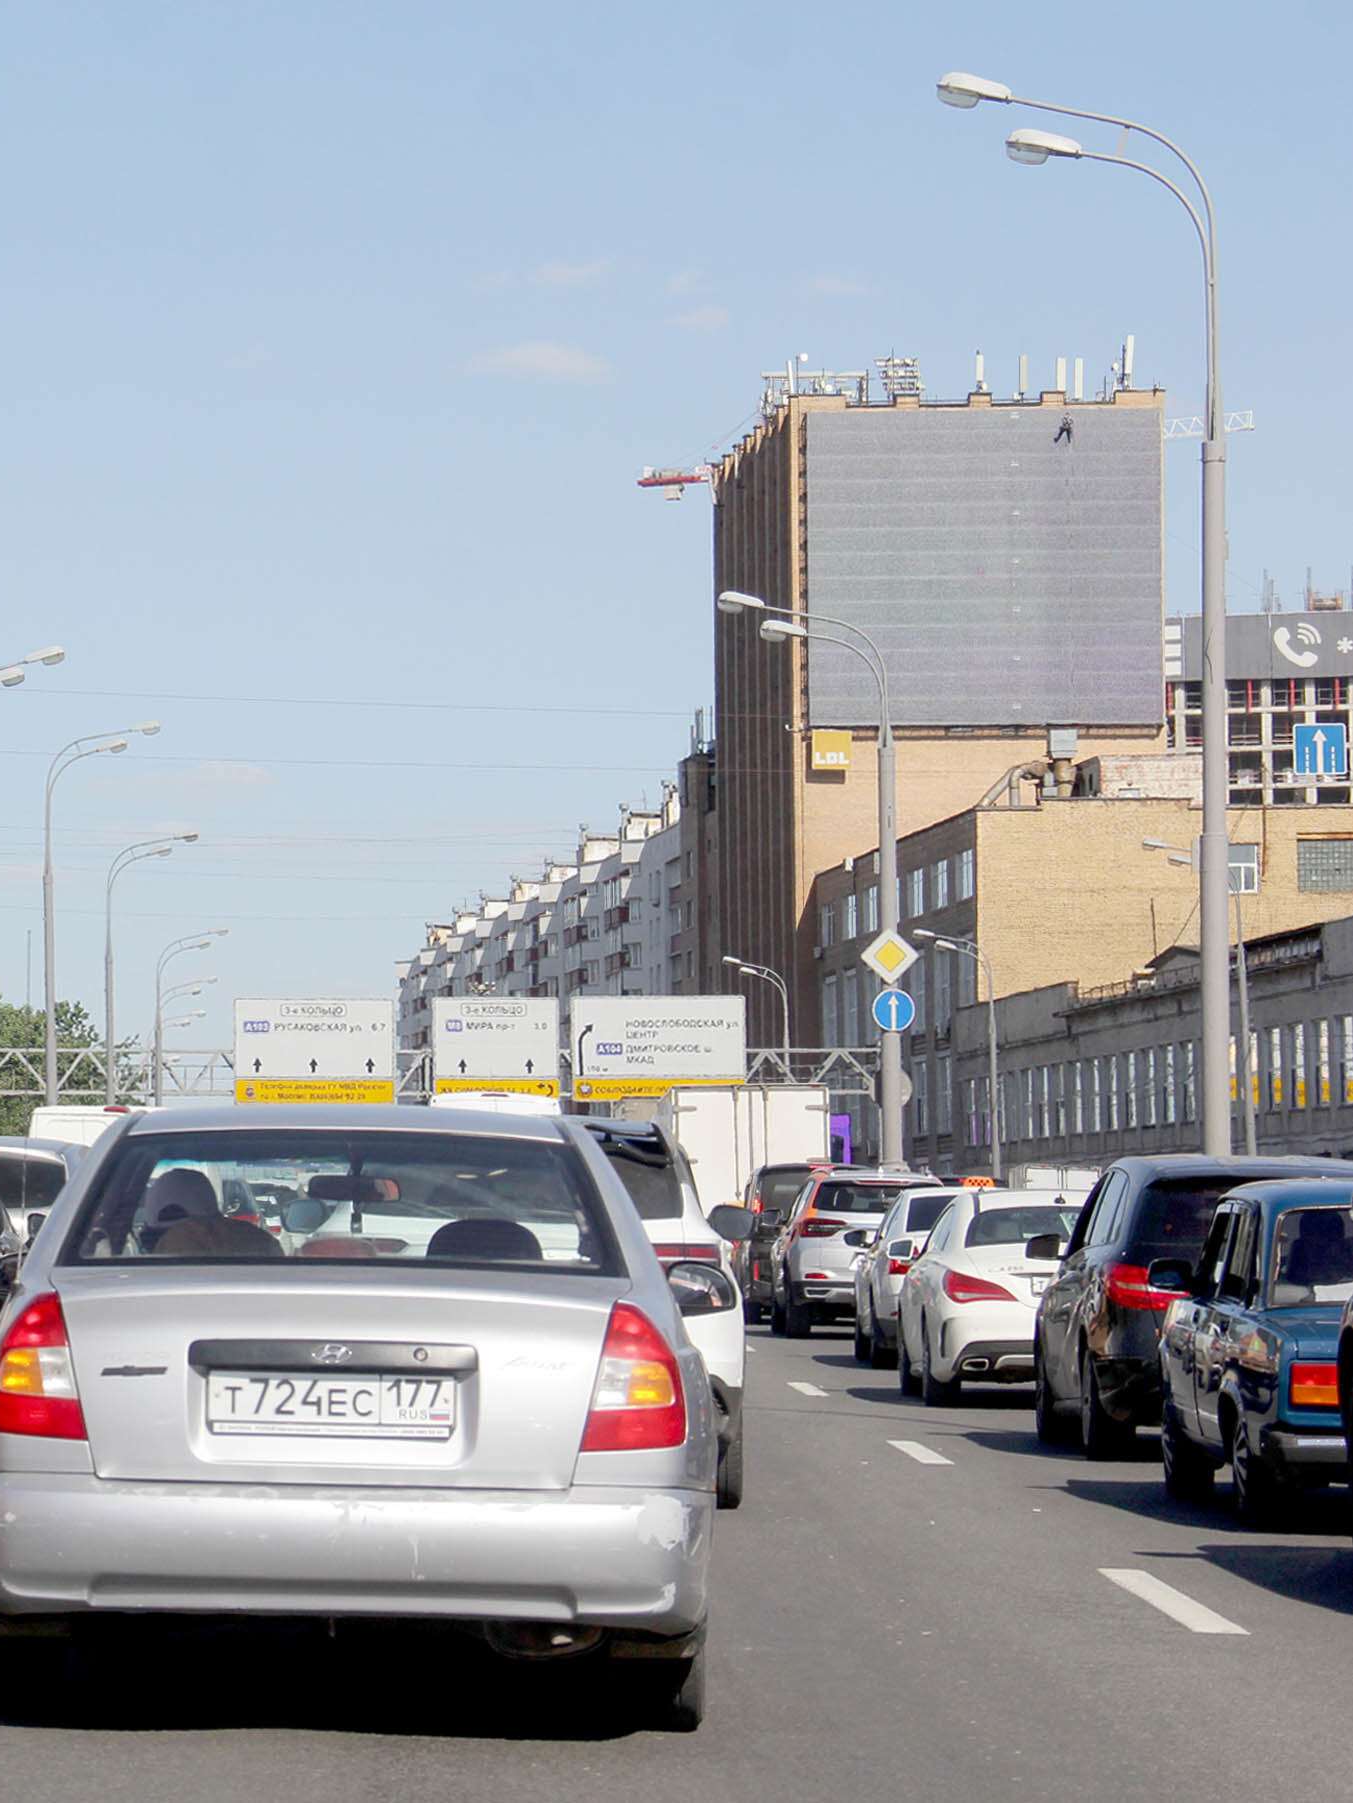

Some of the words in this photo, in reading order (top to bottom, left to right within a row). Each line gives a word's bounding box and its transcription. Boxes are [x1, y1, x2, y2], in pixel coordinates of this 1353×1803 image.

[301, 1005, 344, 1016] КОЛЬЦО
[482, 1005, 524, 1016] КОЛЬЦО
[273, 1023, 347, 1032] РУСАКОВСКАЯ
[625, 1019, 724, 1029] НОВОСЛОБОДСКАЯ
[625, 1031, 659, 1040] ЦЕНТР
[625, 1044, 701, 1054] ДМИТРОВСКОЕ
[626, 1056, 655, 1065] МКАД
[387, 1378, 443, 1408] 177
[398, 1409, 428, 1420] RUS
